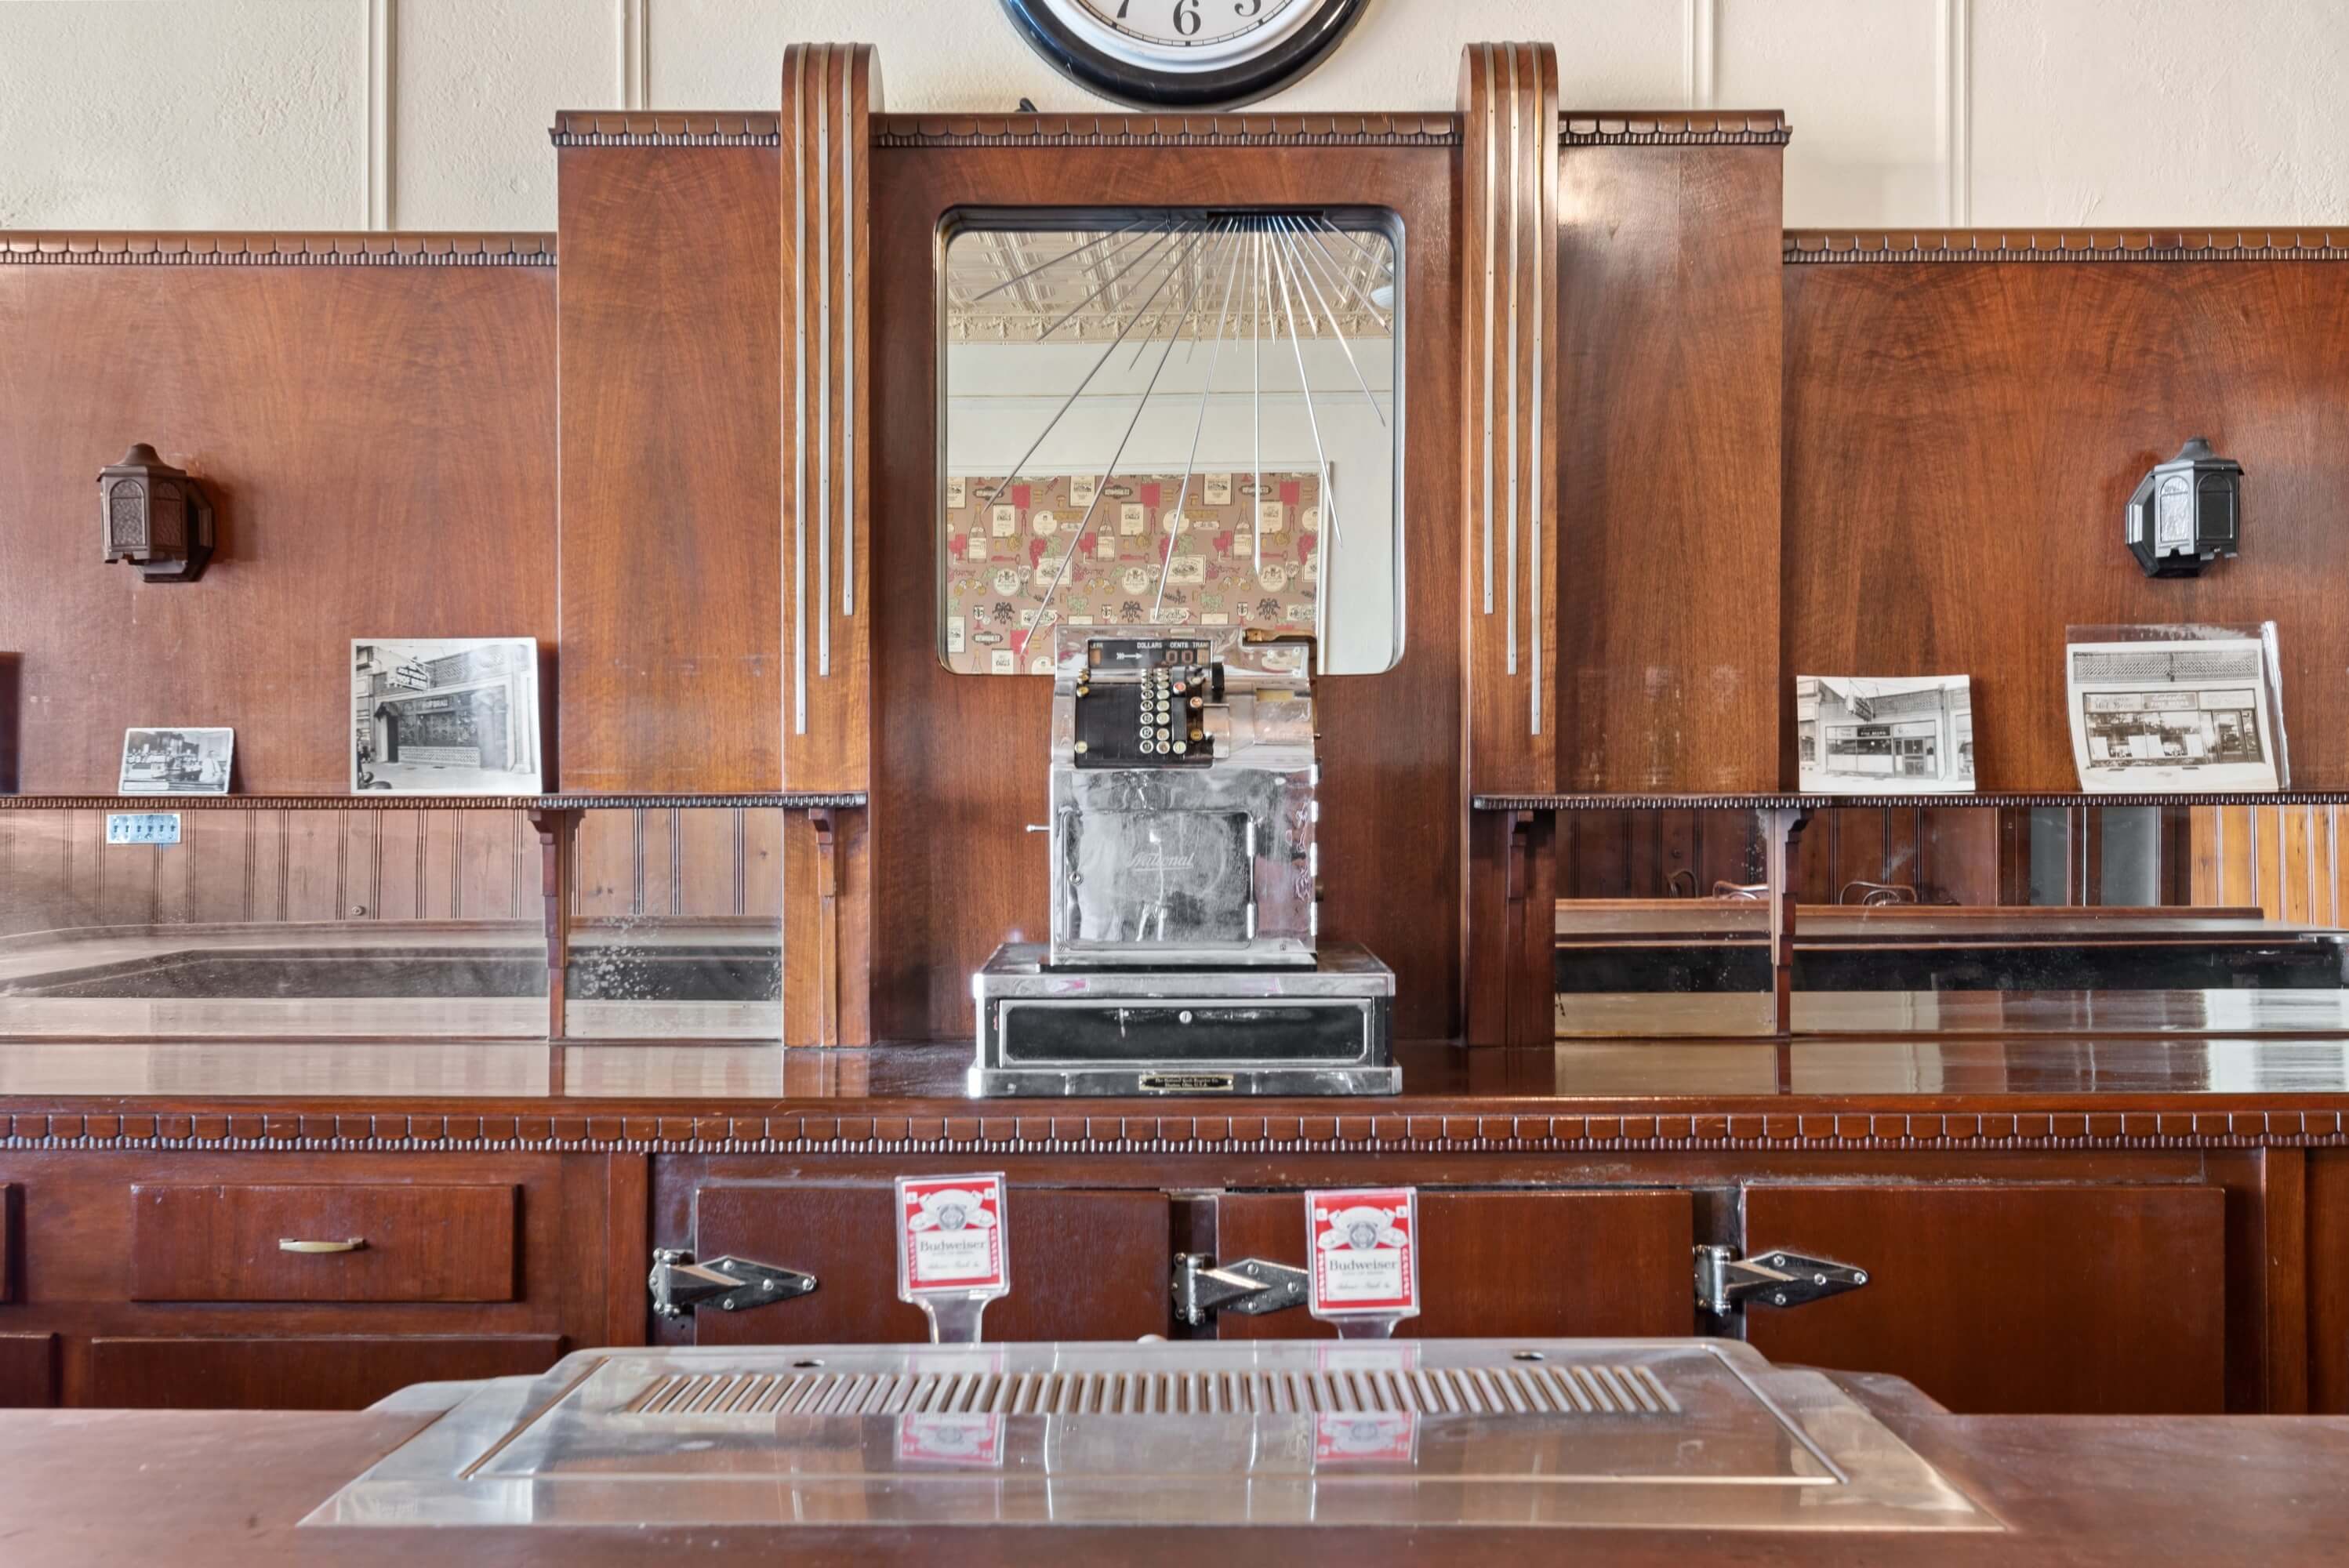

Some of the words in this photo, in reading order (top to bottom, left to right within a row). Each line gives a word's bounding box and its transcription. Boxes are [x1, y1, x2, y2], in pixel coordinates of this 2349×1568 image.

[1173, 0, 1201, 35] 6
[920, 1240, 986, 1252] Budweiser
[1330, 1258, 1396, 1271] Budweiser
